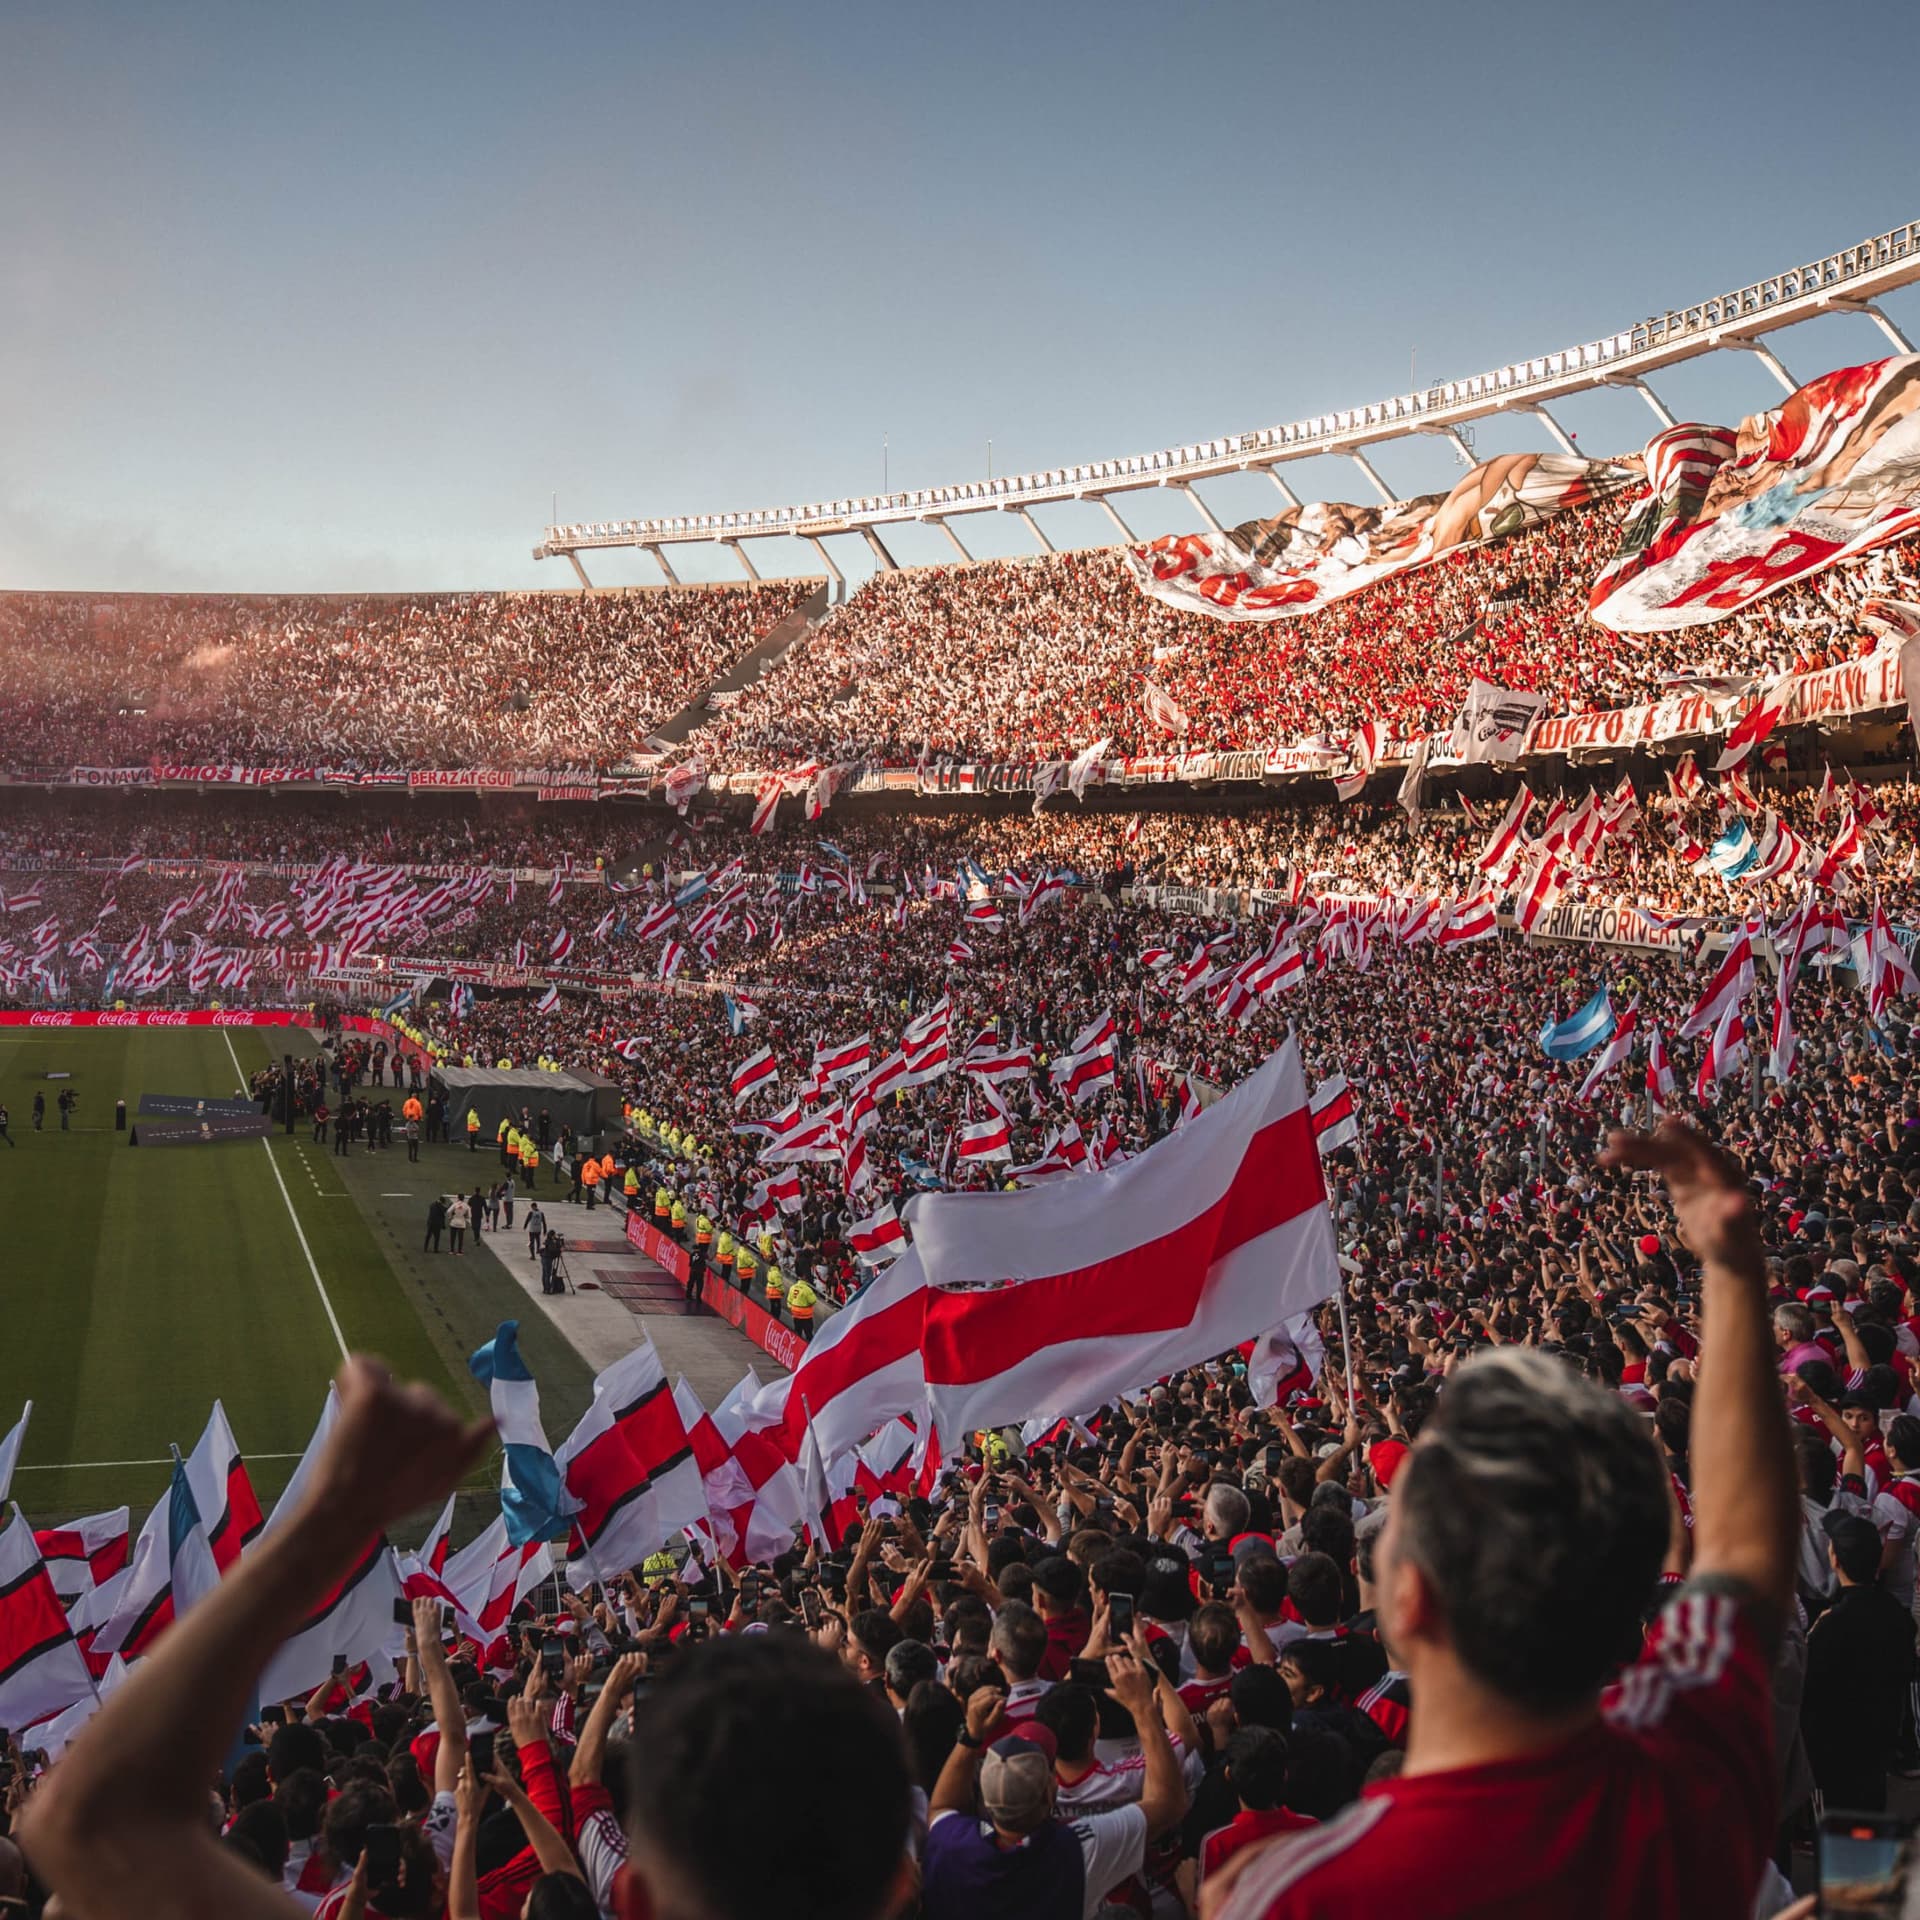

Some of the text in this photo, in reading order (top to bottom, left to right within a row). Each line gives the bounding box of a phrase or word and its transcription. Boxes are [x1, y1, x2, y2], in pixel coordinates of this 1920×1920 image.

[1526, 711, 1623, 750] ADICTO
[74, 769, 151, 785] FONAVI
[411, 770, 511, 786] BERAZATEGUI
[764, 1318, 797, 1370] Coca-Cola
